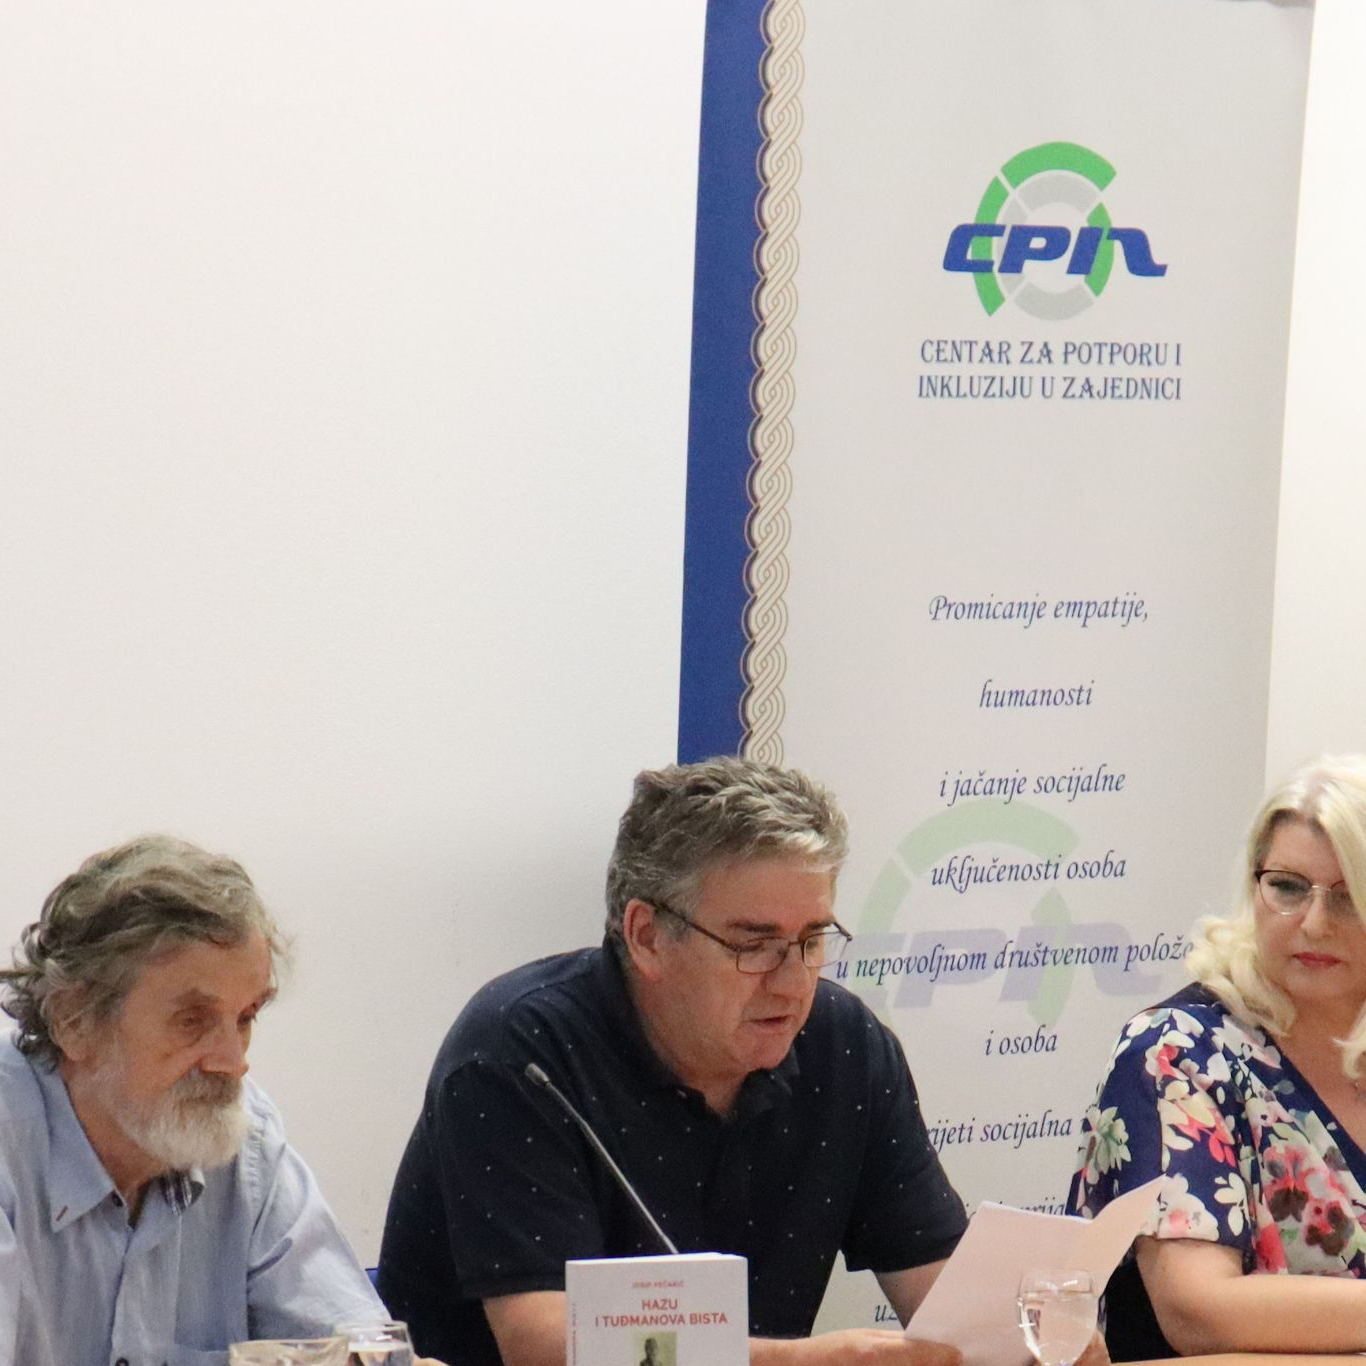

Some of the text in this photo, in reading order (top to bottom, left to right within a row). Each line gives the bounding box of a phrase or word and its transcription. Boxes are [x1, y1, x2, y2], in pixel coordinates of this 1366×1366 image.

[920, 338, 1181, 367] CENTAR ZA POTPORU I
[917, 374, 1181, 400] INKLUZIJU U ZAJEDNICI
[928, 591, 1148, 629] Promicanje empatije,
[978, 678, 1094, 709] humanosti
[940, 763, 1125, 806] i jačanje socijalne
[931, 849, 1127, 893] uključenosti osoba
[835, 960, 849, 980] u
[855, 945, 987, 984] nepovoljnom
[993, 941, 1119, 970] društvenom
[985, 1024, 1057, 1055] i osoba
[980, 1109, 1071, 1148] socijalna
[640, 1297, 679, 1311] HAZU
[601, 1312, 686, 1329] TUĐMANOVA
[688, 1311, 729, 1326] BISTA
